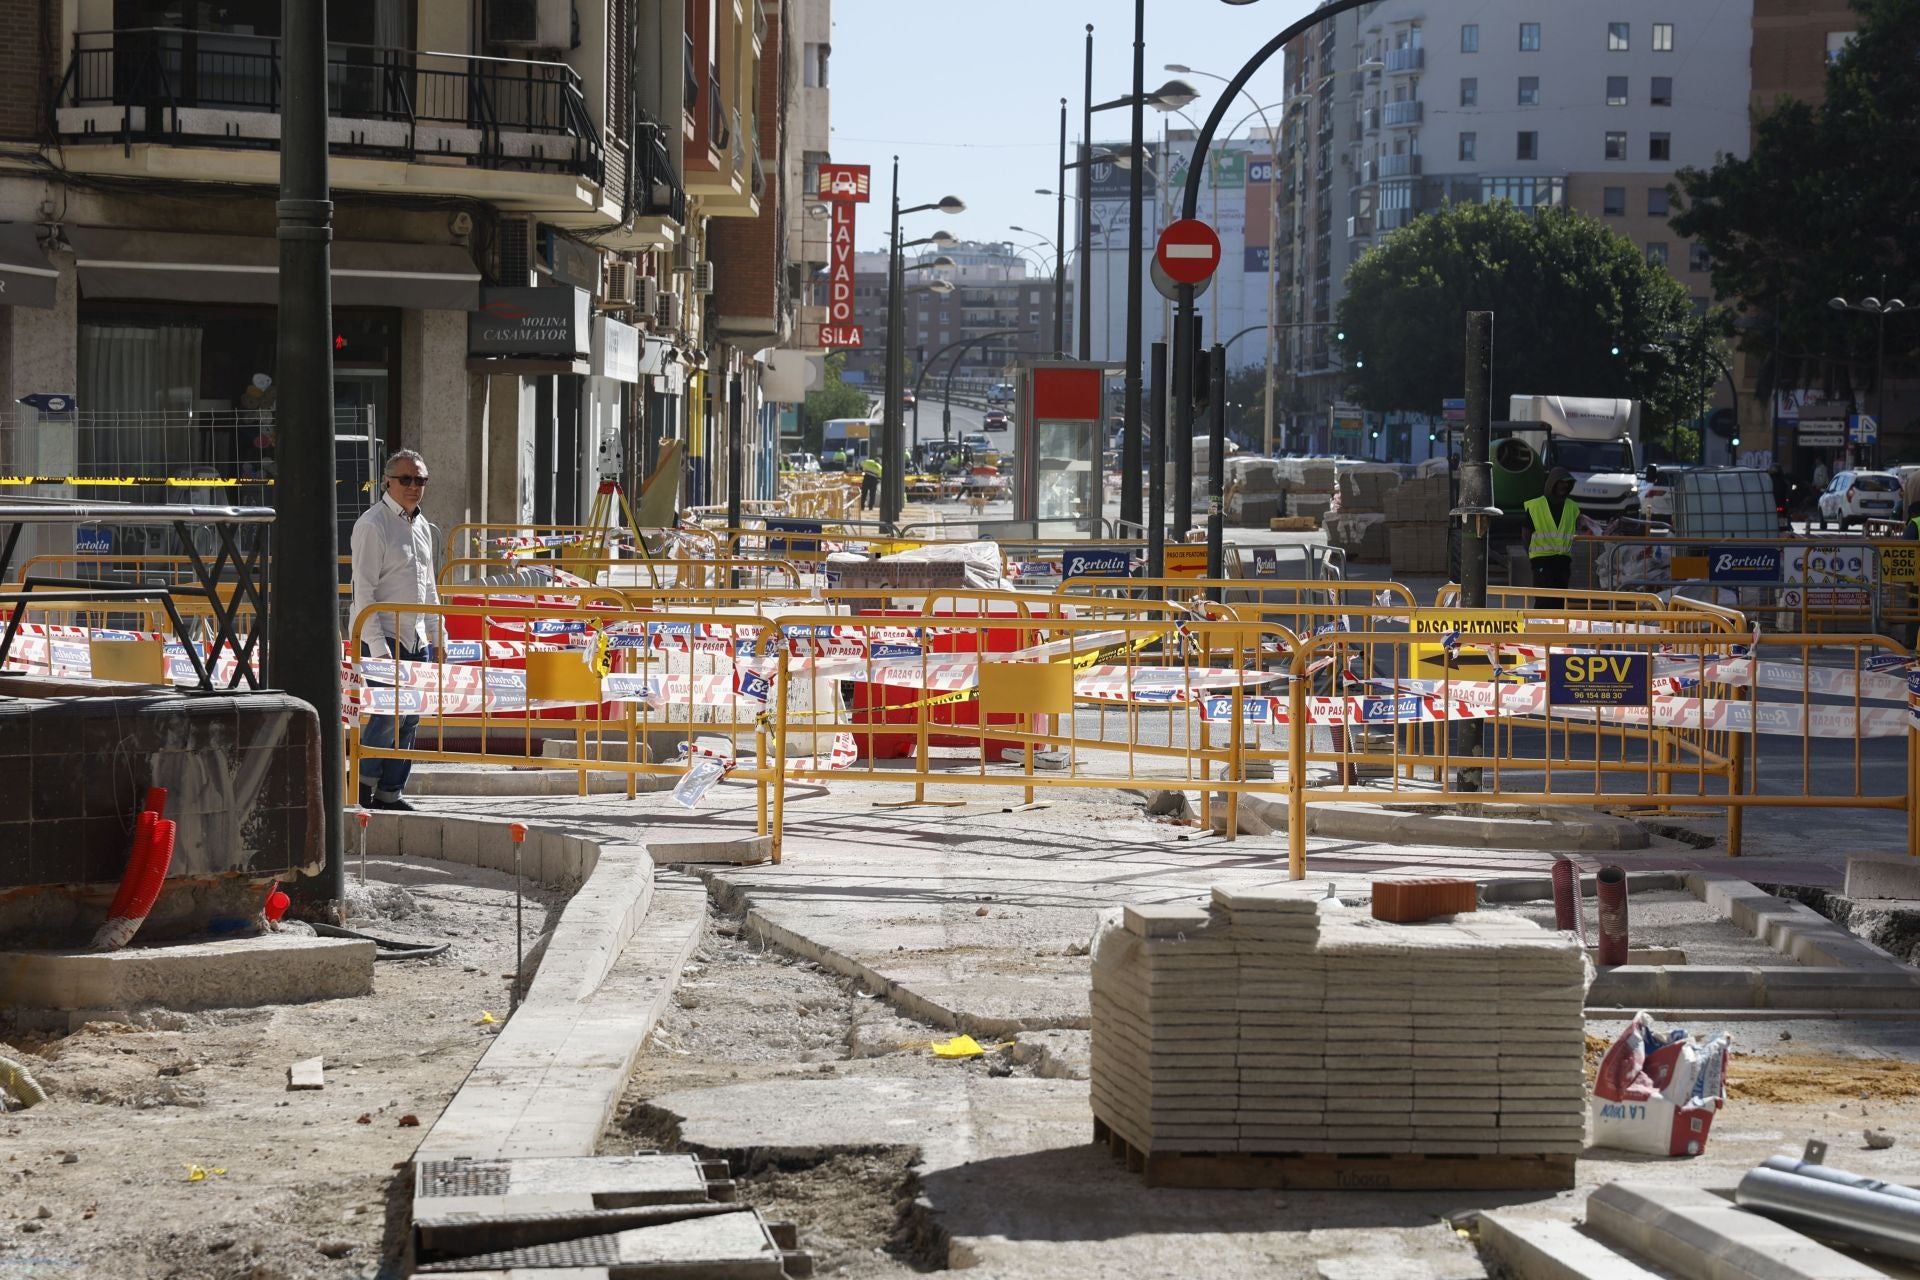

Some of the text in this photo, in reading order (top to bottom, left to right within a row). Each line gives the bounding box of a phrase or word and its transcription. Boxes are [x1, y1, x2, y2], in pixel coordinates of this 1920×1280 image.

[834, 206, 850, 320] LAVADO
[521, 317, 567, 327] MOLINA
[483, 329, 567, 341] CASAMAYOR
[821, 328, 860, 345] SILA
[1167, 551, 1179, 559] PASO
[1883, 549, 1916, 559] ACCE
[1068, 556, 1126, 577] Bertolín
[1715, 553, 1776, 574] Bertolín
[1892, 559, 1915, 568] SOL
[1883, 567, 1915, 577] VECIN
[740, 627, 749, 636] NO
[1417, 620, 1518, 634] PASO PEATONES
[703, 643, 726, 652] PASAR
[827, 647, 837, 656] NO
[838, 647, 862, 657] PASAR
[1565, 656, 1632, 683] SPV
[340, 670, 349, 681] NO
[1314, 706, 1326, 716] NO
[1631, 1104, 1646, 1120] LA
